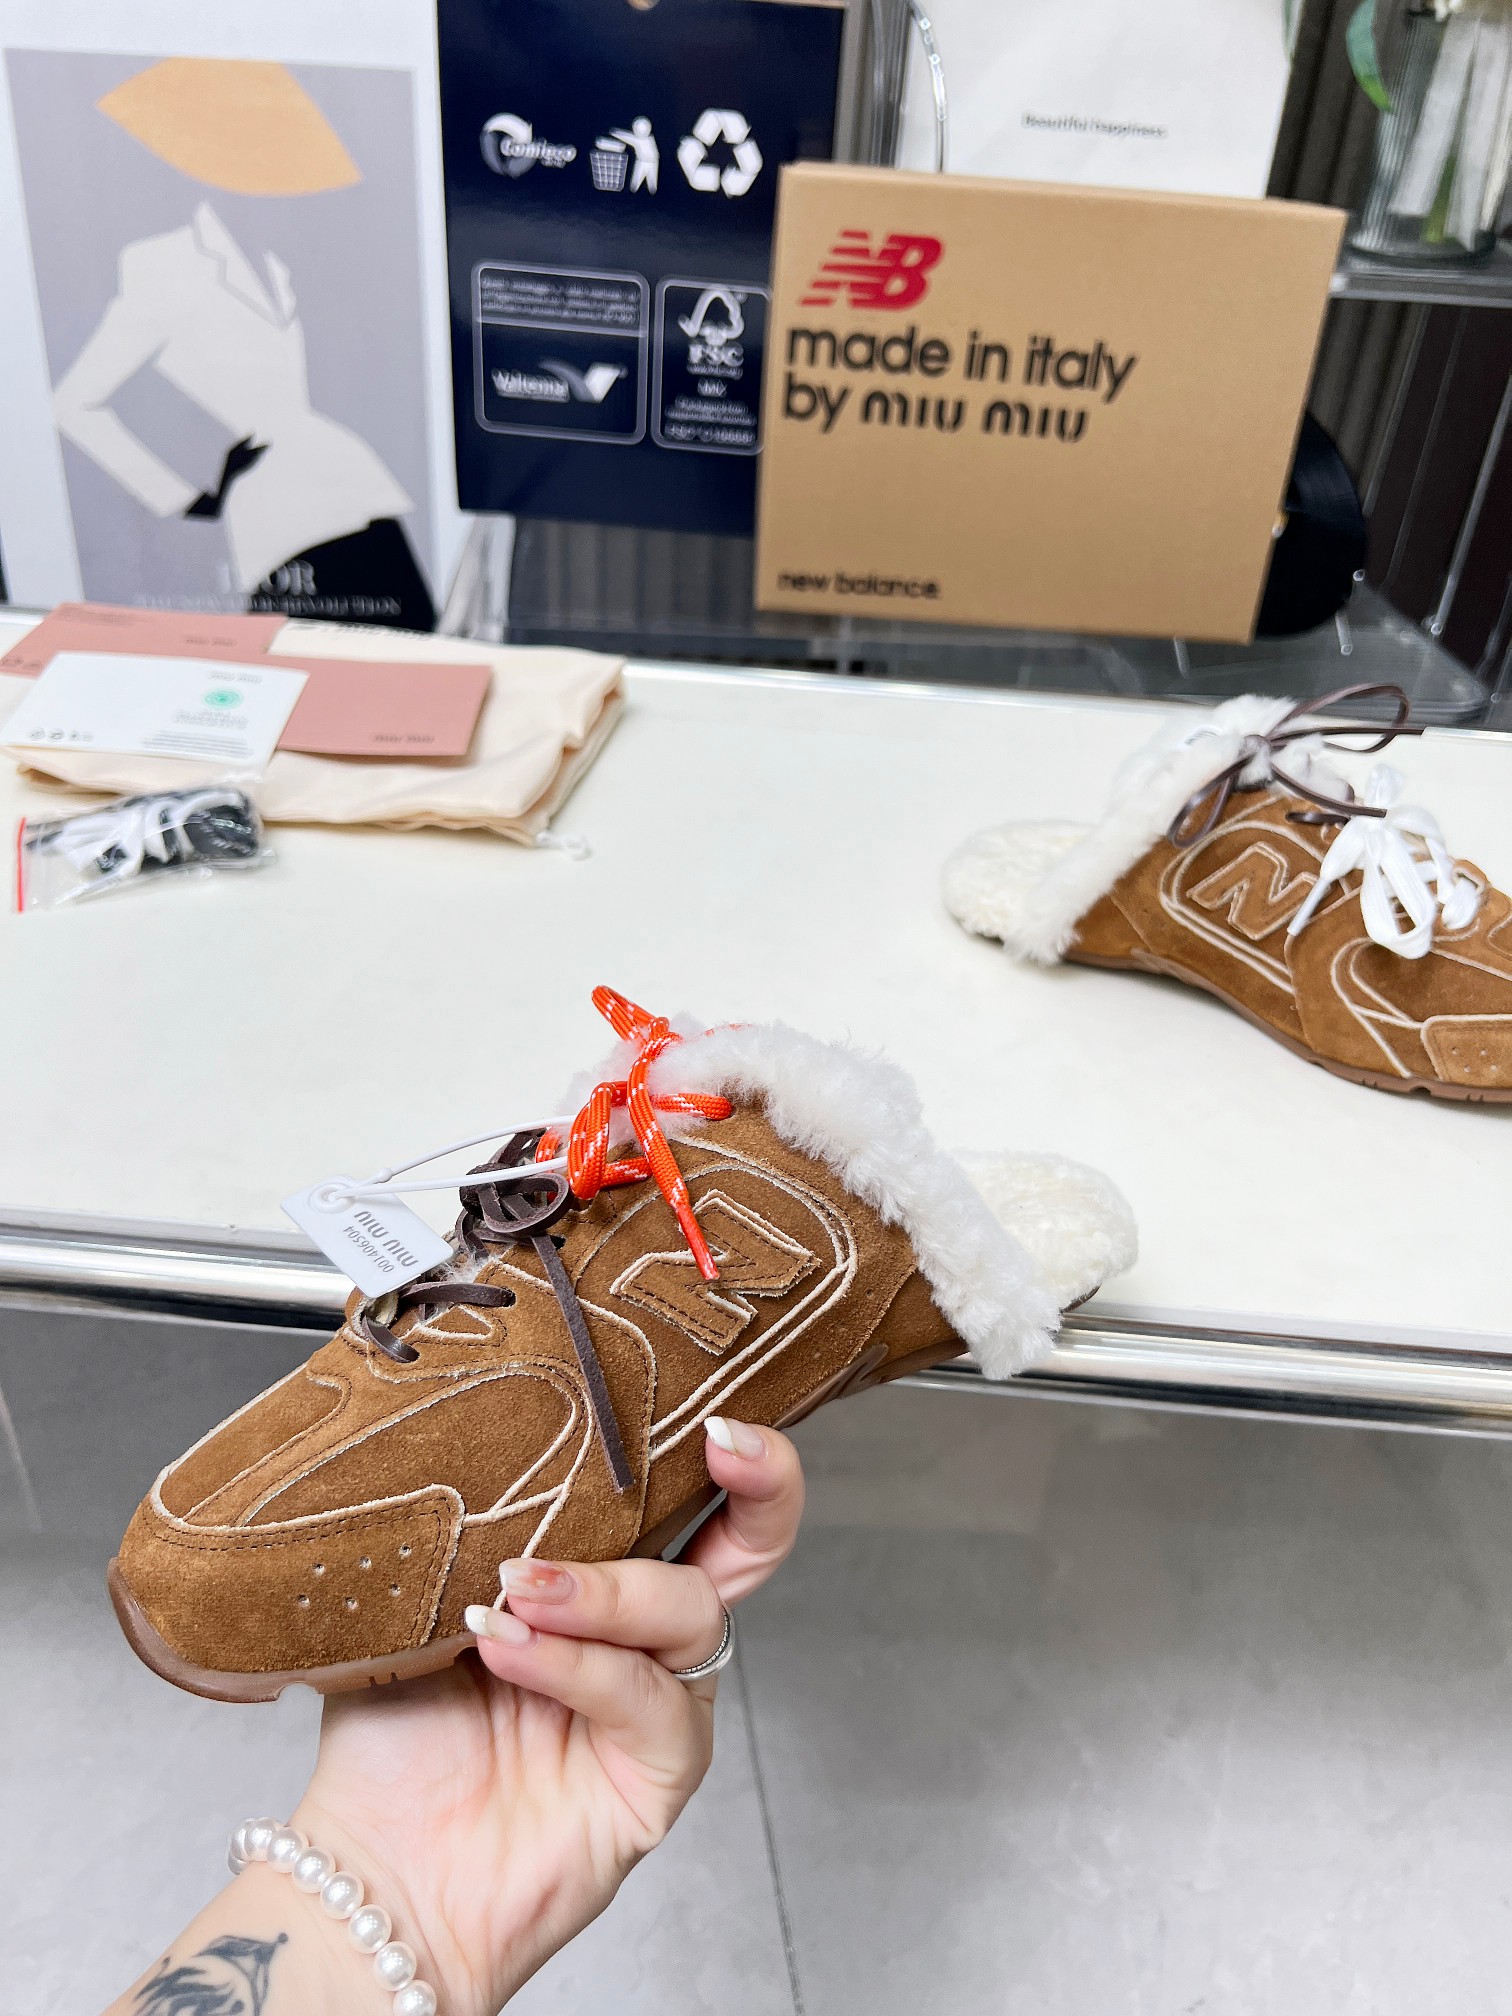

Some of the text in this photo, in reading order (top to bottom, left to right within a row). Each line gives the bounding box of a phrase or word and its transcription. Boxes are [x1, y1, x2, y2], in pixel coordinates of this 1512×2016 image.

[787, 325, 1139, 404] made in italy
[781, 372, 852, 433] by
[777, 571, 942, 600] new balance
